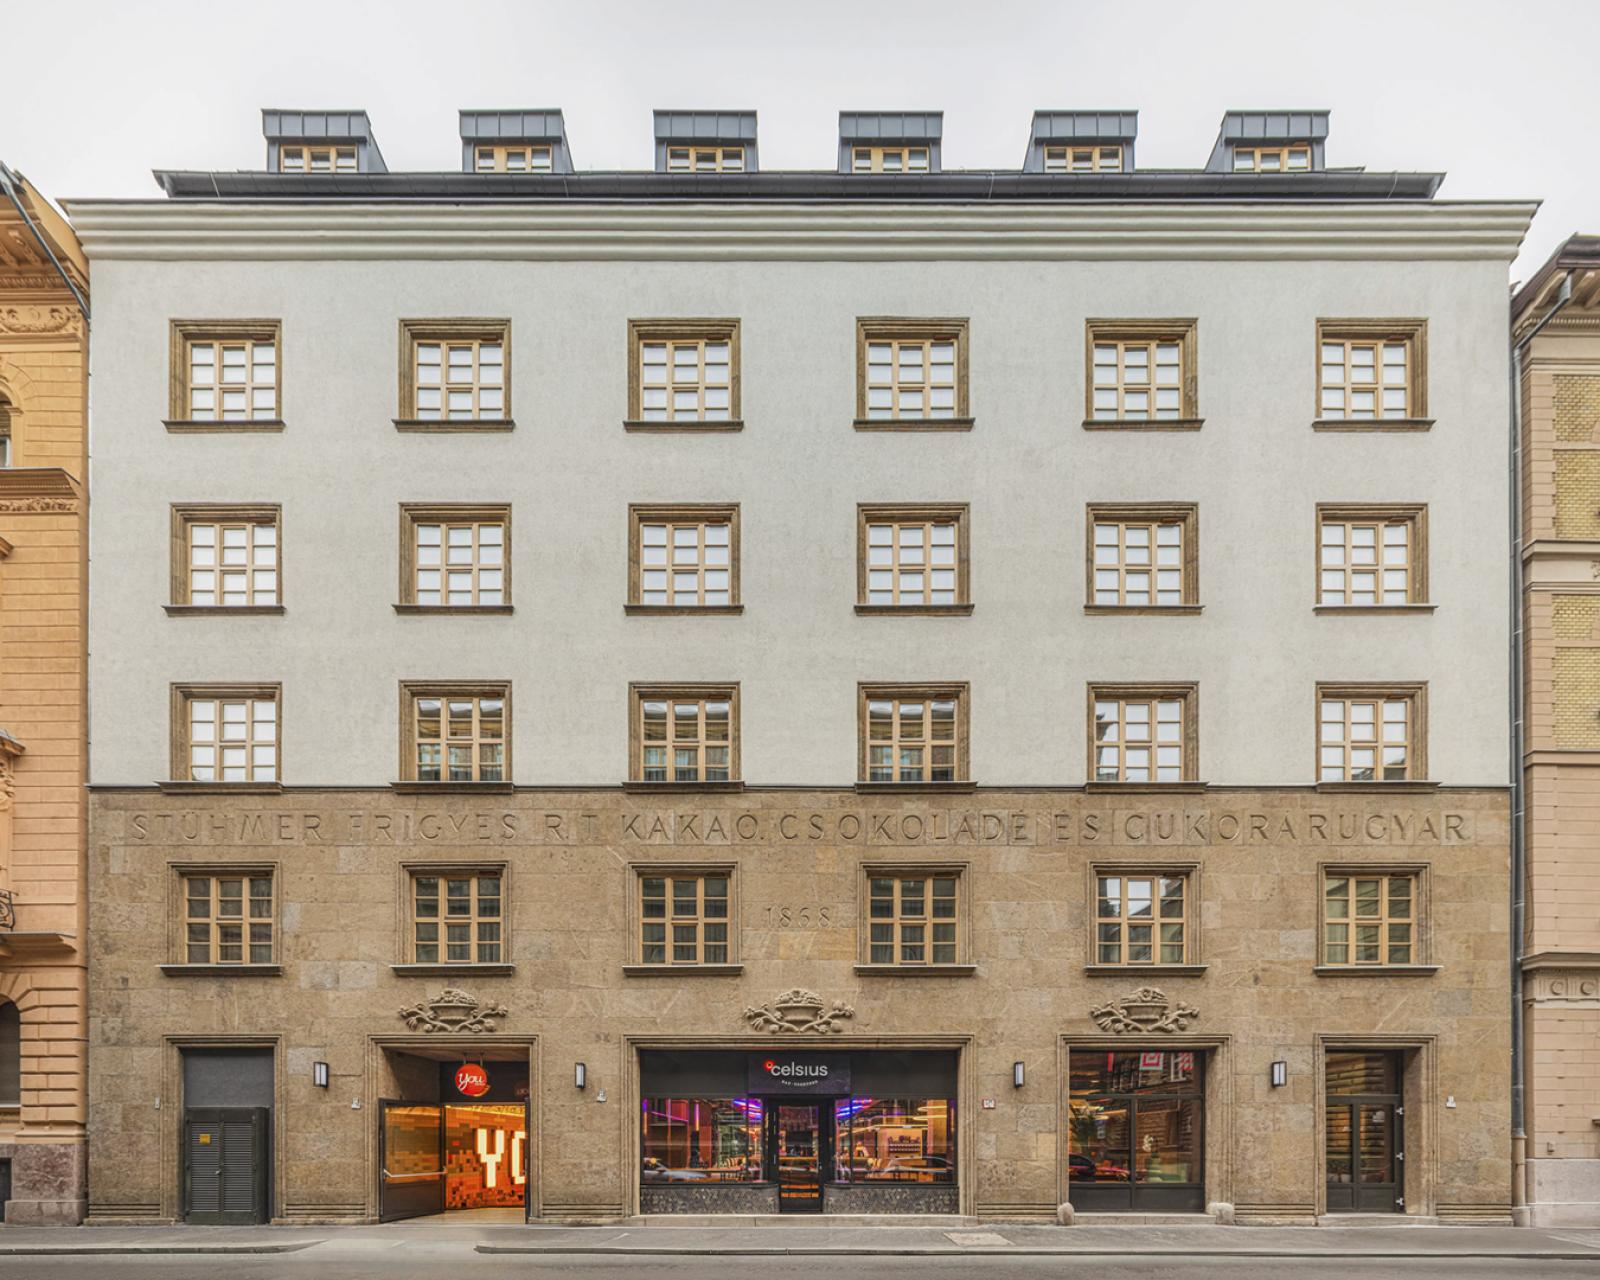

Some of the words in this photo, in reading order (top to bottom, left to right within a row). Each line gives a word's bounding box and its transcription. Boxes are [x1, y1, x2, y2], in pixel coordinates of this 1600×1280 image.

[131, 811, 324, 841] STÜHMER
[349, 814, 519, 841] FRIGYES
[765, 906, 831, 928] 1868
